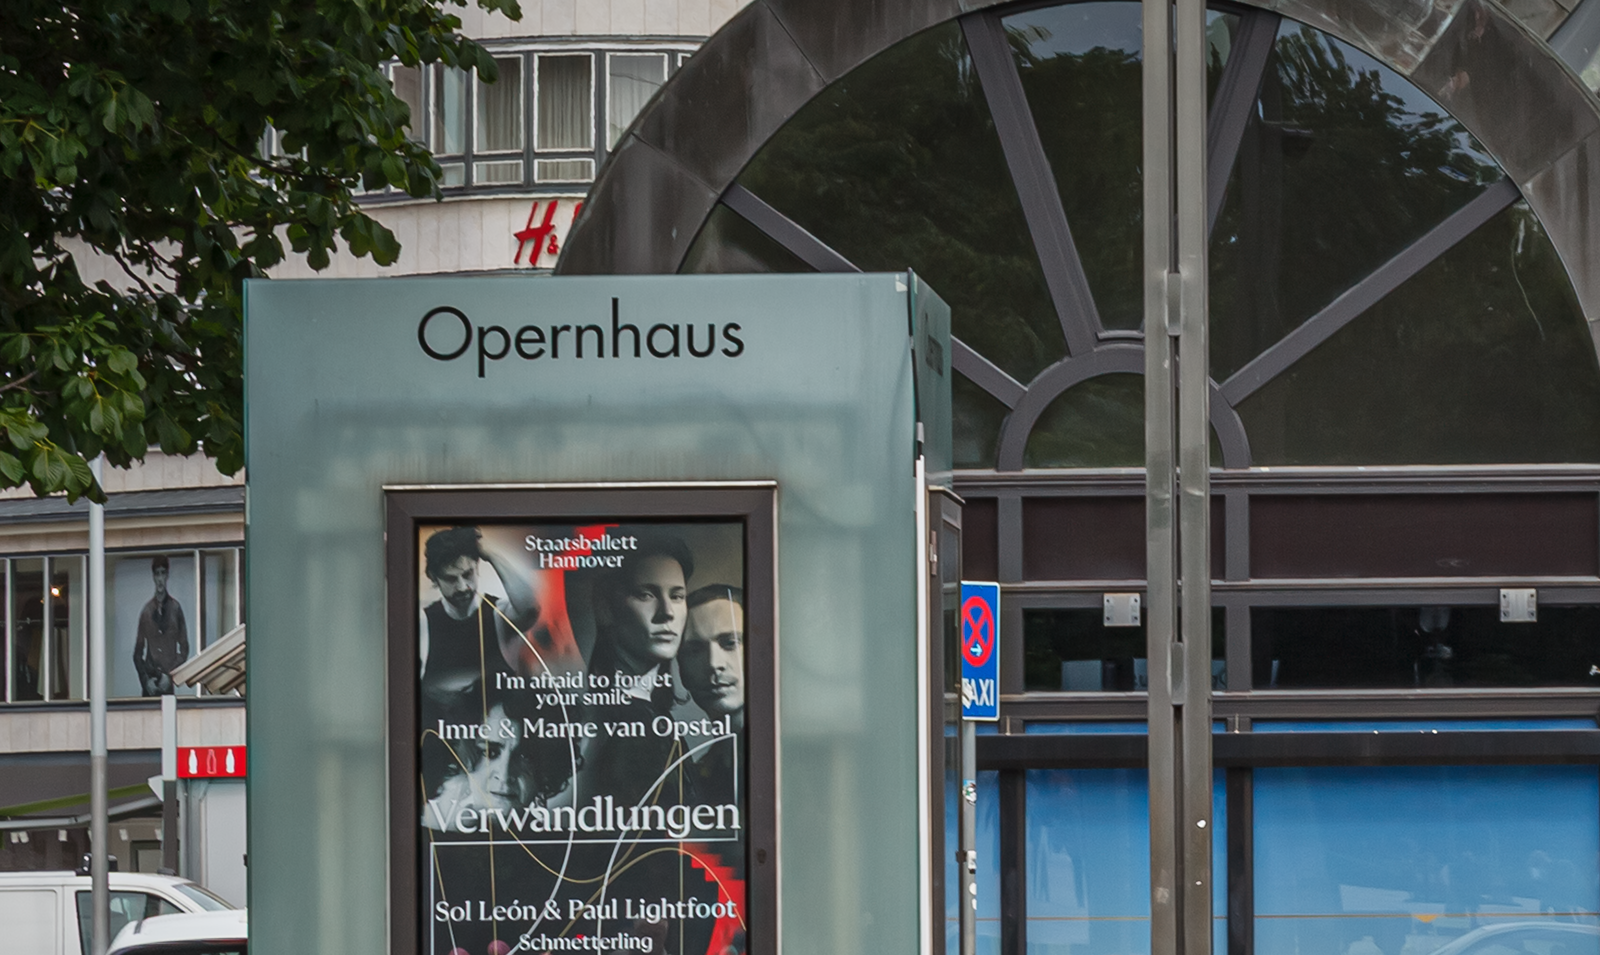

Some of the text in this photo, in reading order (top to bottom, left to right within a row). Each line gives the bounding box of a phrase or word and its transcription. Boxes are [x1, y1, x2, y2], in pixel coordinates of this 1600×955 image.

[513, 199, 584, 267] H&
[417, 297, 745, 378] Opernhaus
[525, 534, 638, 552] Staatsballett
[539, 552, 624, 569] Hannover
[530, 671, 584, 689] afraid
[588, 674, 610, 689] to
[614, 669, 673, 696] forget
[535, 688, 633, 711] your smile
[437, 719, 492, 740] Imre
[498, 719, 516, 739] &
[604, 721, 646, 738] van
[651, 714, 733, 740] Opstal
[427, 795, 742, 839] Verwandlungen
[435, 896, 737, 924] Sol León & Paul Lightfoot
[518, 932, 653, 953] Schmetterling
